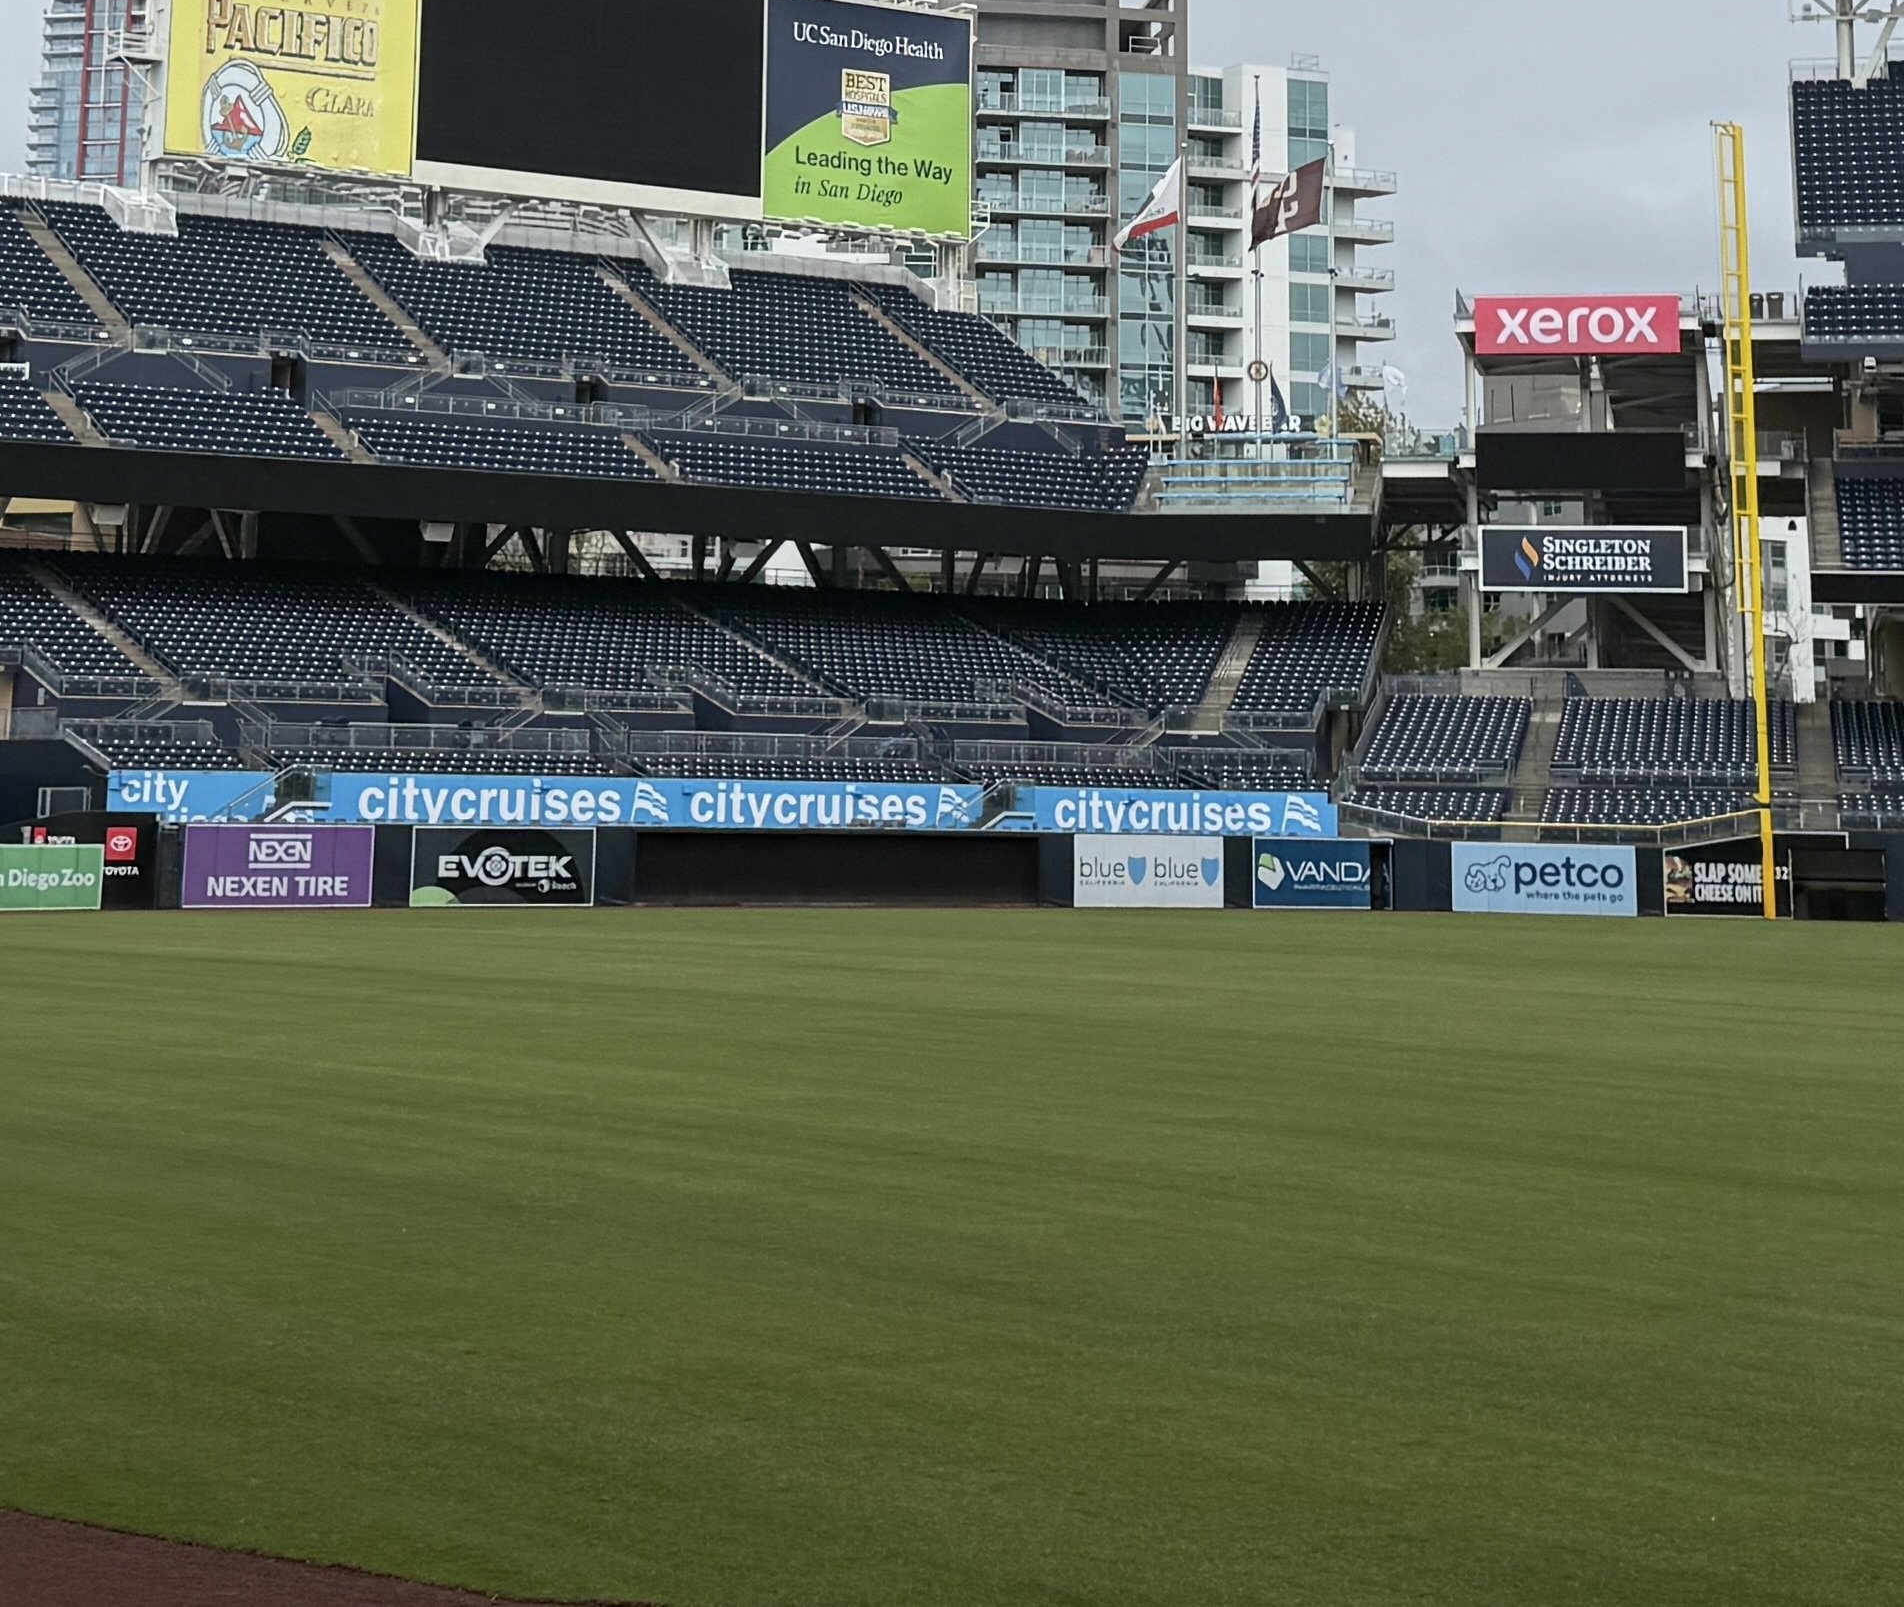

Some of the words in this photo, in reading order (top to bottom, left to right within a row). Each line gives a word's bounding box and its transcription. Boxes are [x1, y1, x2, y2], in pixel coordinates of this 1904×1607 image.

[793, 21, 817, 44] UC
[819, 25, 848, 49] San
[851, 30, 893, 57] Diego
[895, 36, 944, 60] Health
[845, 72, 887, 92] BEST
[795, 145, 872, 176] Leading
[876, 156, 908, 176] the
[913, 159, 953, 185] Way
[794, 175, 811, 195] in
[818, 179, 849, 199] San
[856, 183, 903, 207] Diego
[1496, 306, 1659, 344] xerox
[1262, 415, 1301, 432] BR
[1542, 536, 1651, 554] SINGLETON
[1542, 554, 1652, 571] SCHREIBER
[120, 771, 189, 811] city
[358, 777, 622, 824] citycruises
[690, 781, 927, 828] citycruises
[1054, 790, 1272, 833] citycruises
[249, 840, 312, 862] NEXEN
[437, 846, 574, 886] EVOTEK
[1079, 856, 1125, 878] blue
[1154, 857, 1199, 879] blue
[1514, 856, 1625, 894] petco
[1694, 862, 1726, 883] SLAP
[1727, 862, 1763, 884] SOME
[8, 868, 58, 890] Diego
[61, 868, 95, 887] Zoo
[206, 876, 288, 897] NEXEN
[294, 876, 349, 896] TIRE
[1694, 884, 1735, 902] CHEESE
[1735, 884, 1752, 903] ON
